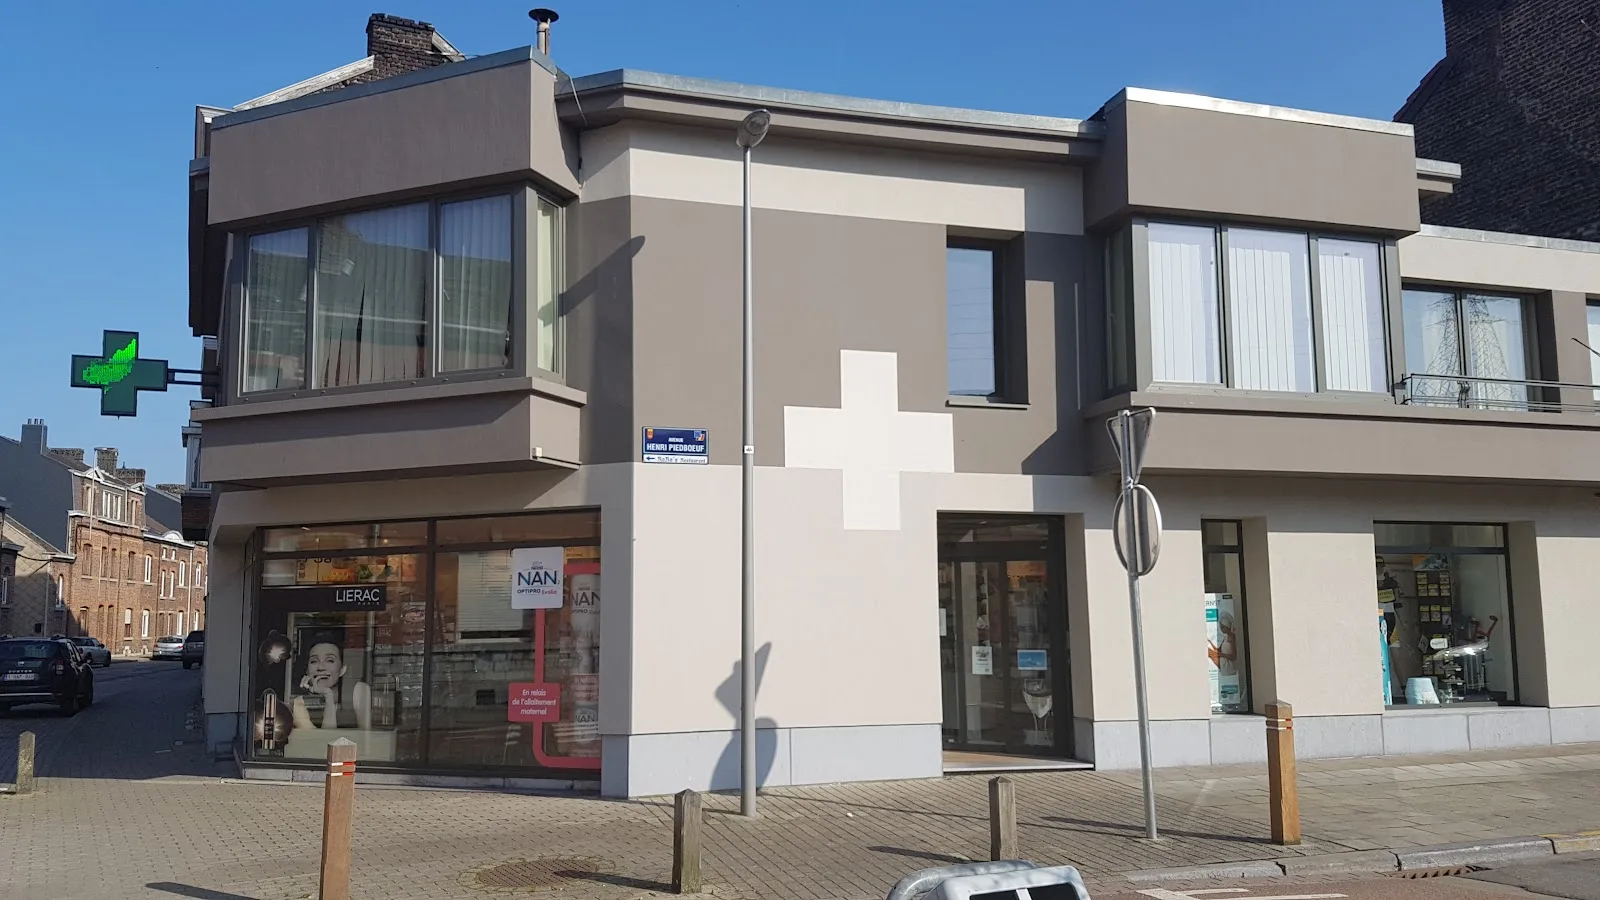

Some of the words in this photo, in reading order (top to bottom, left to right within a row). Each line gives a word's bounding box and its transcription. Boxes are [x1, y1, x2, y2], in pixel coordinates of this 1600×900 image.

[646, 443, 667, 451] HENRI
[668, 444, 705, 452] PIEDBOEUF
[517, 571, 557, 586] NAN
[335, 588, 380, 602] LIERAC
[520, 698, 557, 706] l'allaitement
